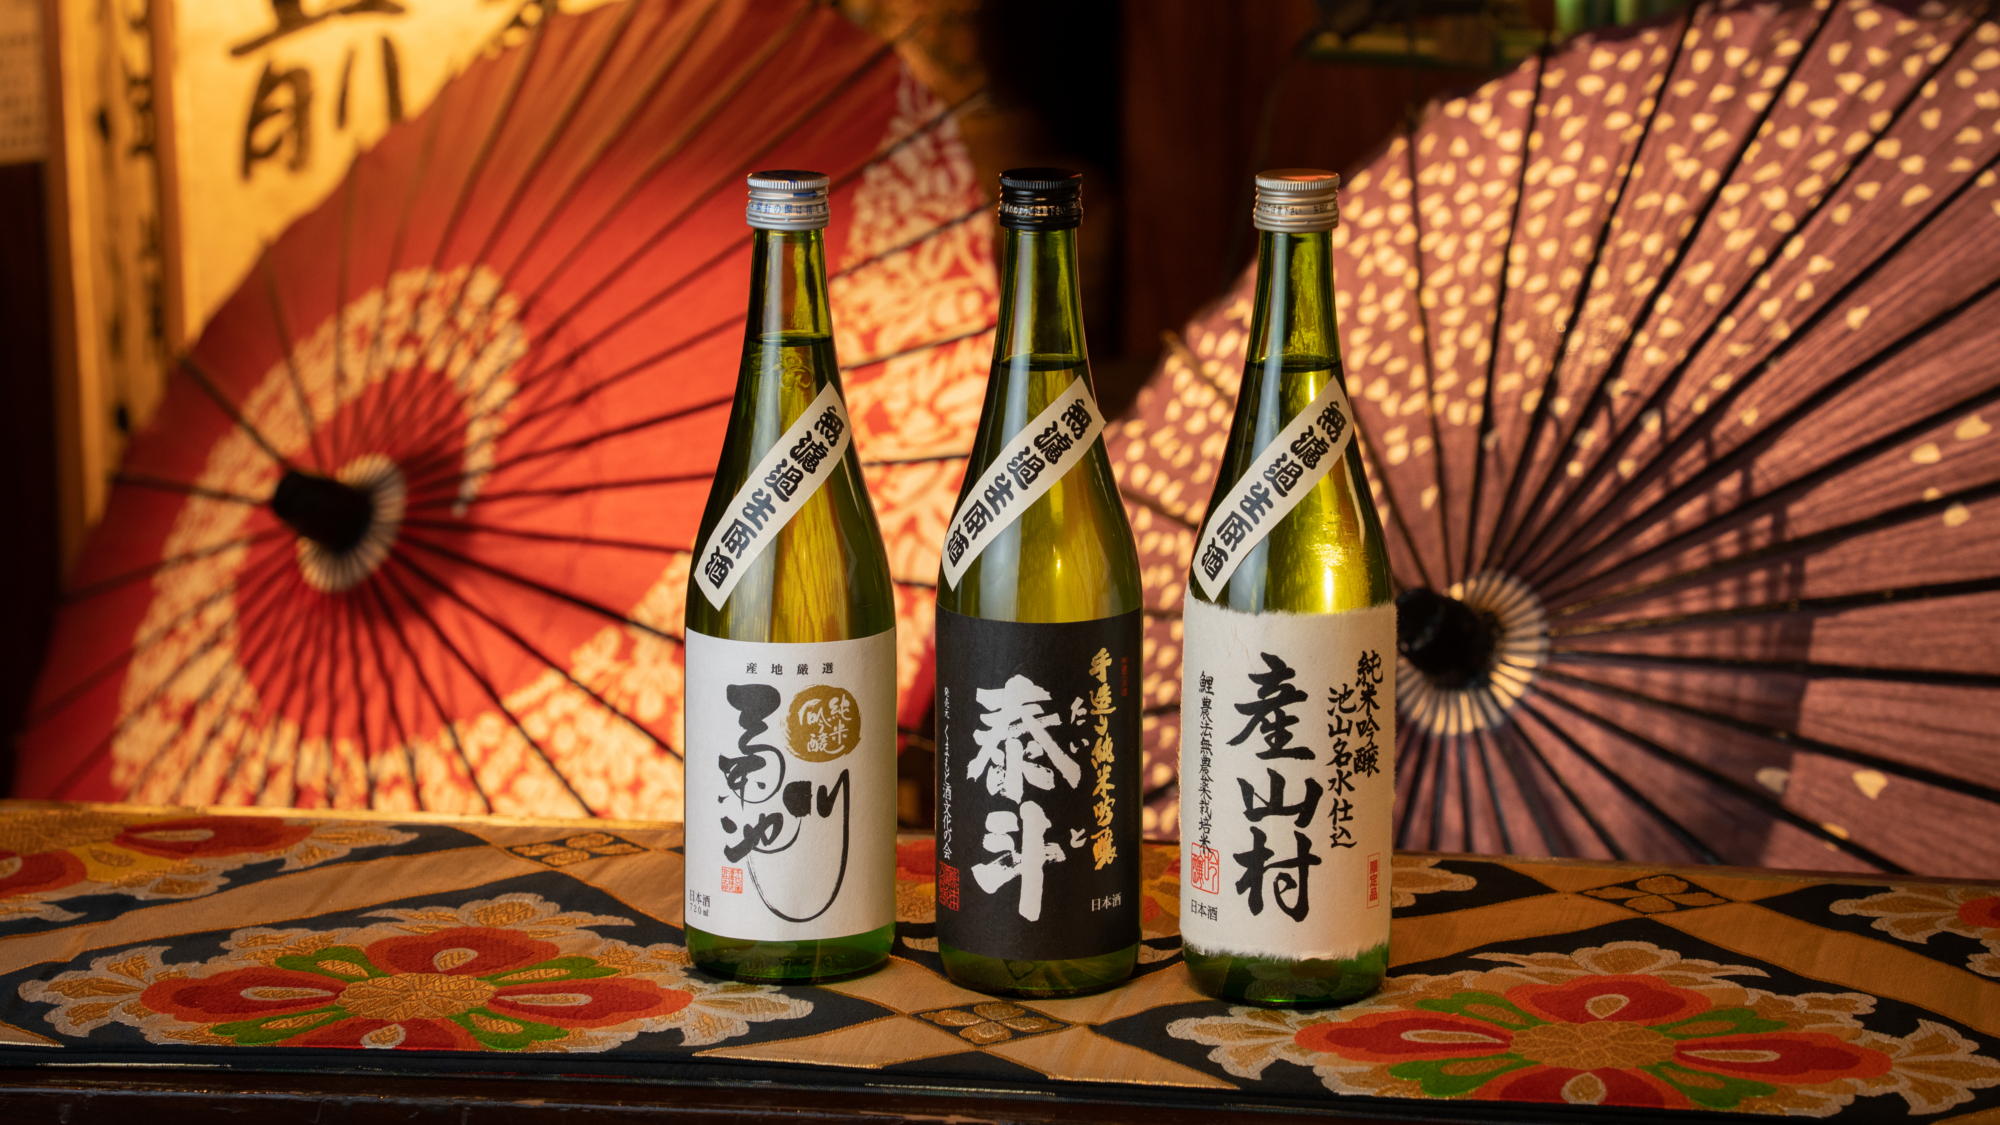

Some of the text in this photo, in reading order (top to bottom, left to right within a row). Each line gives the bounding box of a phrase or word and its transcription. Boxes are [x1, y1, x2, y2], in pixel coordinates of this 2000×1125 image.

[705, 405, 844, 589] 無濾過生原酒
[947, 398, 1092, 567] 無濾過生原酒
[1201, 401, 1346, 581] 無濾過生原酒
[746, 662, 833, 675] 産地厳選
[1353, 650, 1383, 778] 純米吟醸
[966, 674, 1082, 922] 泰斗
[1089, 647, 1117, 871] 手造り純米吟醸
[1226, 652, 1324, 922] 産山村
[1326, 683, 1358, 848] 池山名水仕込
[689, 889, 711, 907] 日本酒
[1091, 893, 1122, 912] 日本酒
[1191, 899, 1218, 921] 日本酒
